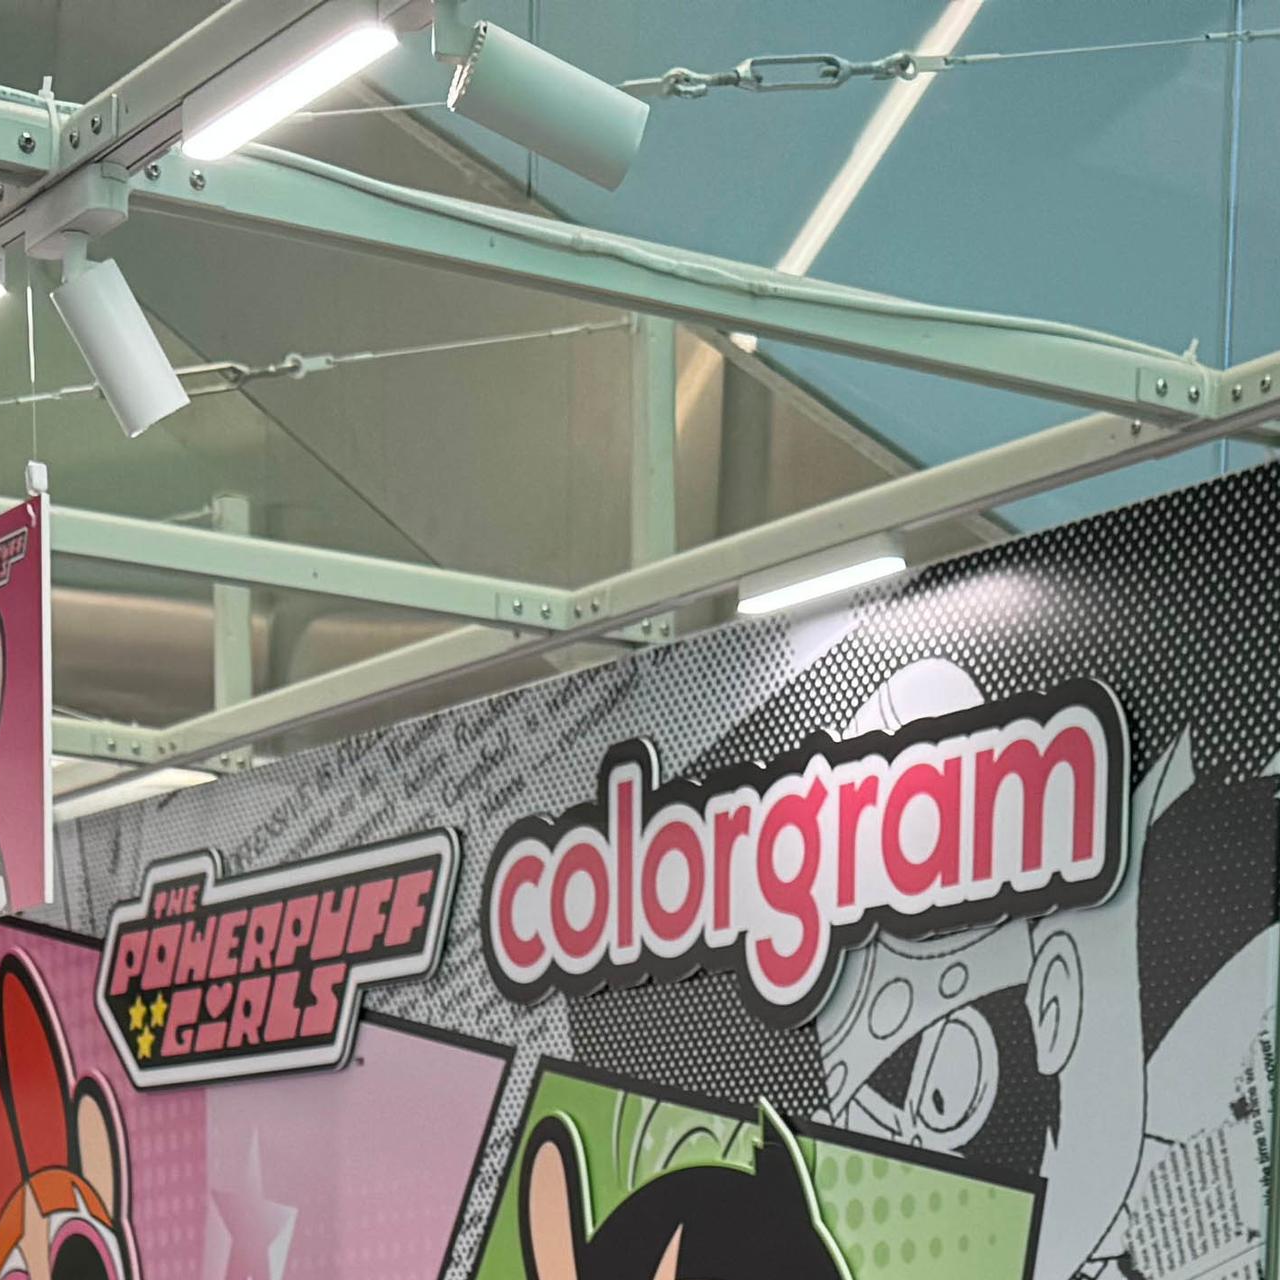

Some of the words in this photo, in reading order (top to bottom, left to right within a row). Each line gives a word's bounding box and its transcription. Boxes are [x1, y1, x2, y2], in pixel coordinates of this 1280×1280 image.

[152, 883, 201, 917] THE
[497, 725, 1094, 990] colorgram
[108, 869, 435, 997] POWERPUFF
[164, 962, 350, 1057] GIRLS
